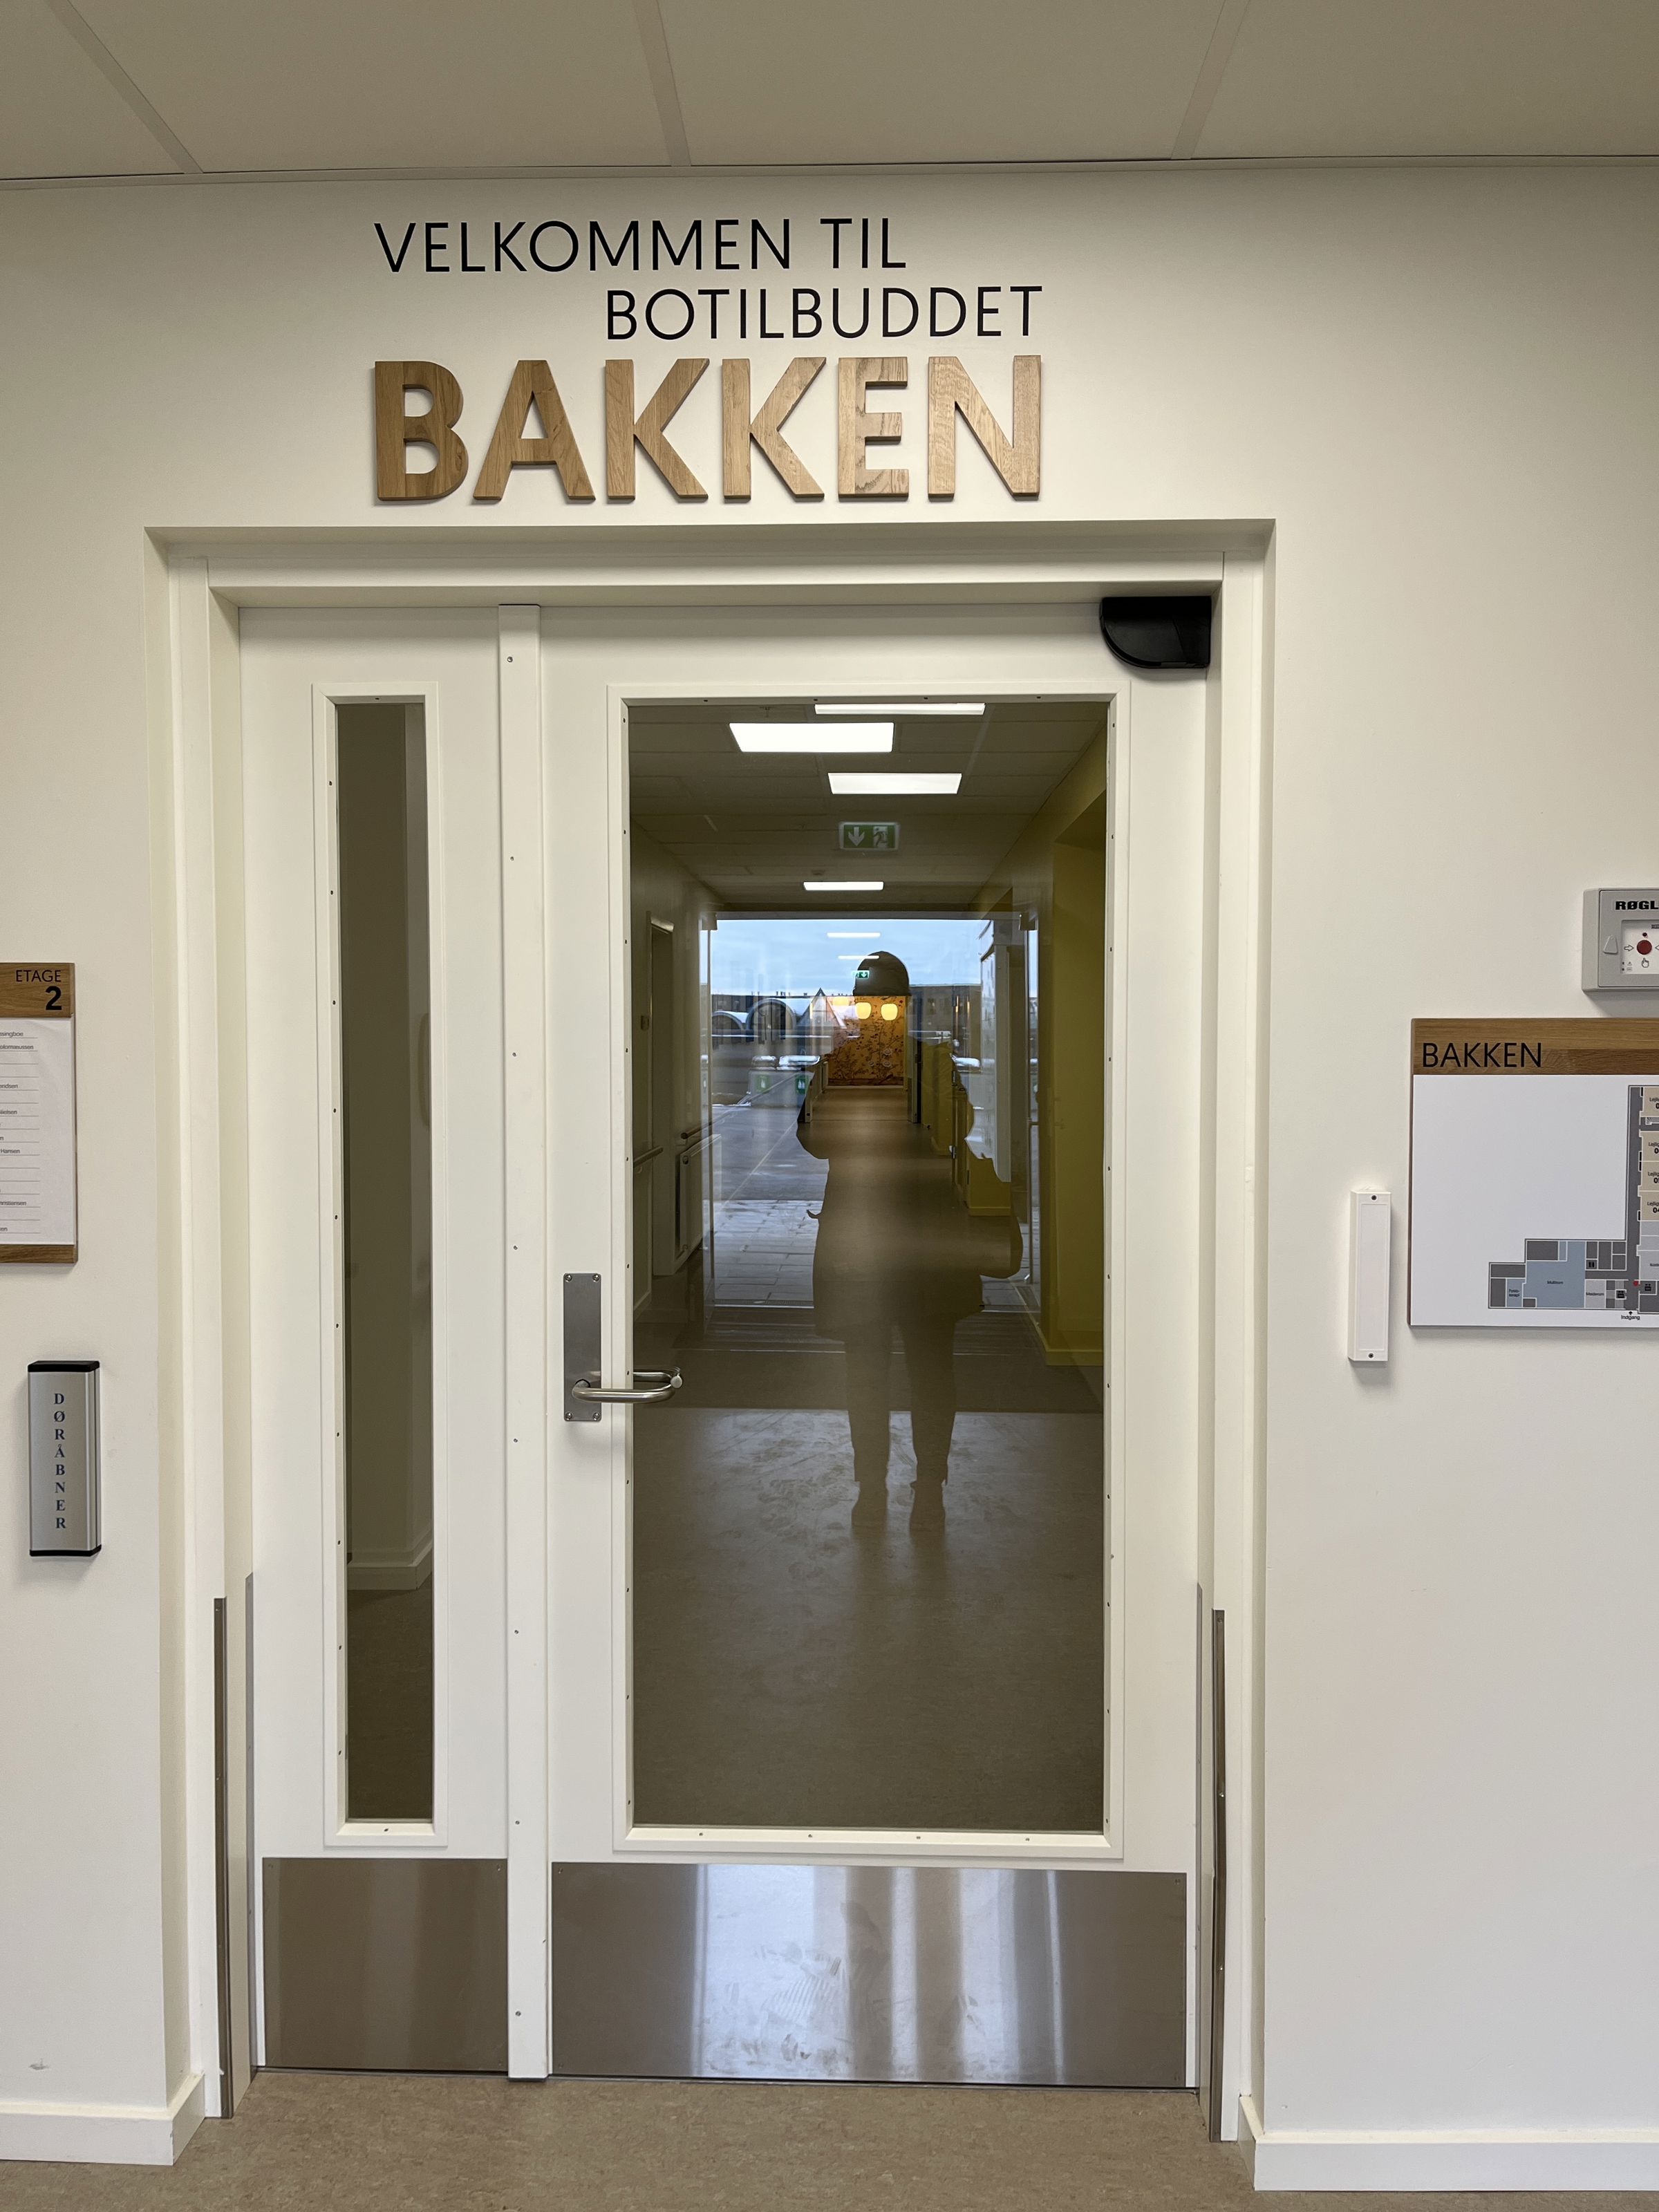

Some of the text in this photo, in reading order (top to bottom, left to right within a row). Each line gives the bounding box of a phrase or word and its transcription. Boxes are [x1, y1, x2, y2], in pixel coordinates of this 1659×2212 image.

[374, 217, 906, 272] VELKOMMEN TIL
[606, 286, 1042, 340] BOTILBUDDET
[374, 355, 1042, 502] BAKKEN
[1615, 900, 1659, 910] RØGL
[16, 970, 61, 982] ETAGE
[45, 986, 62, 1010] 2
[1423, 1042, 1542, 1068] BAKKEN
[54, 1392, 66, 1529] DØRÅBNER
